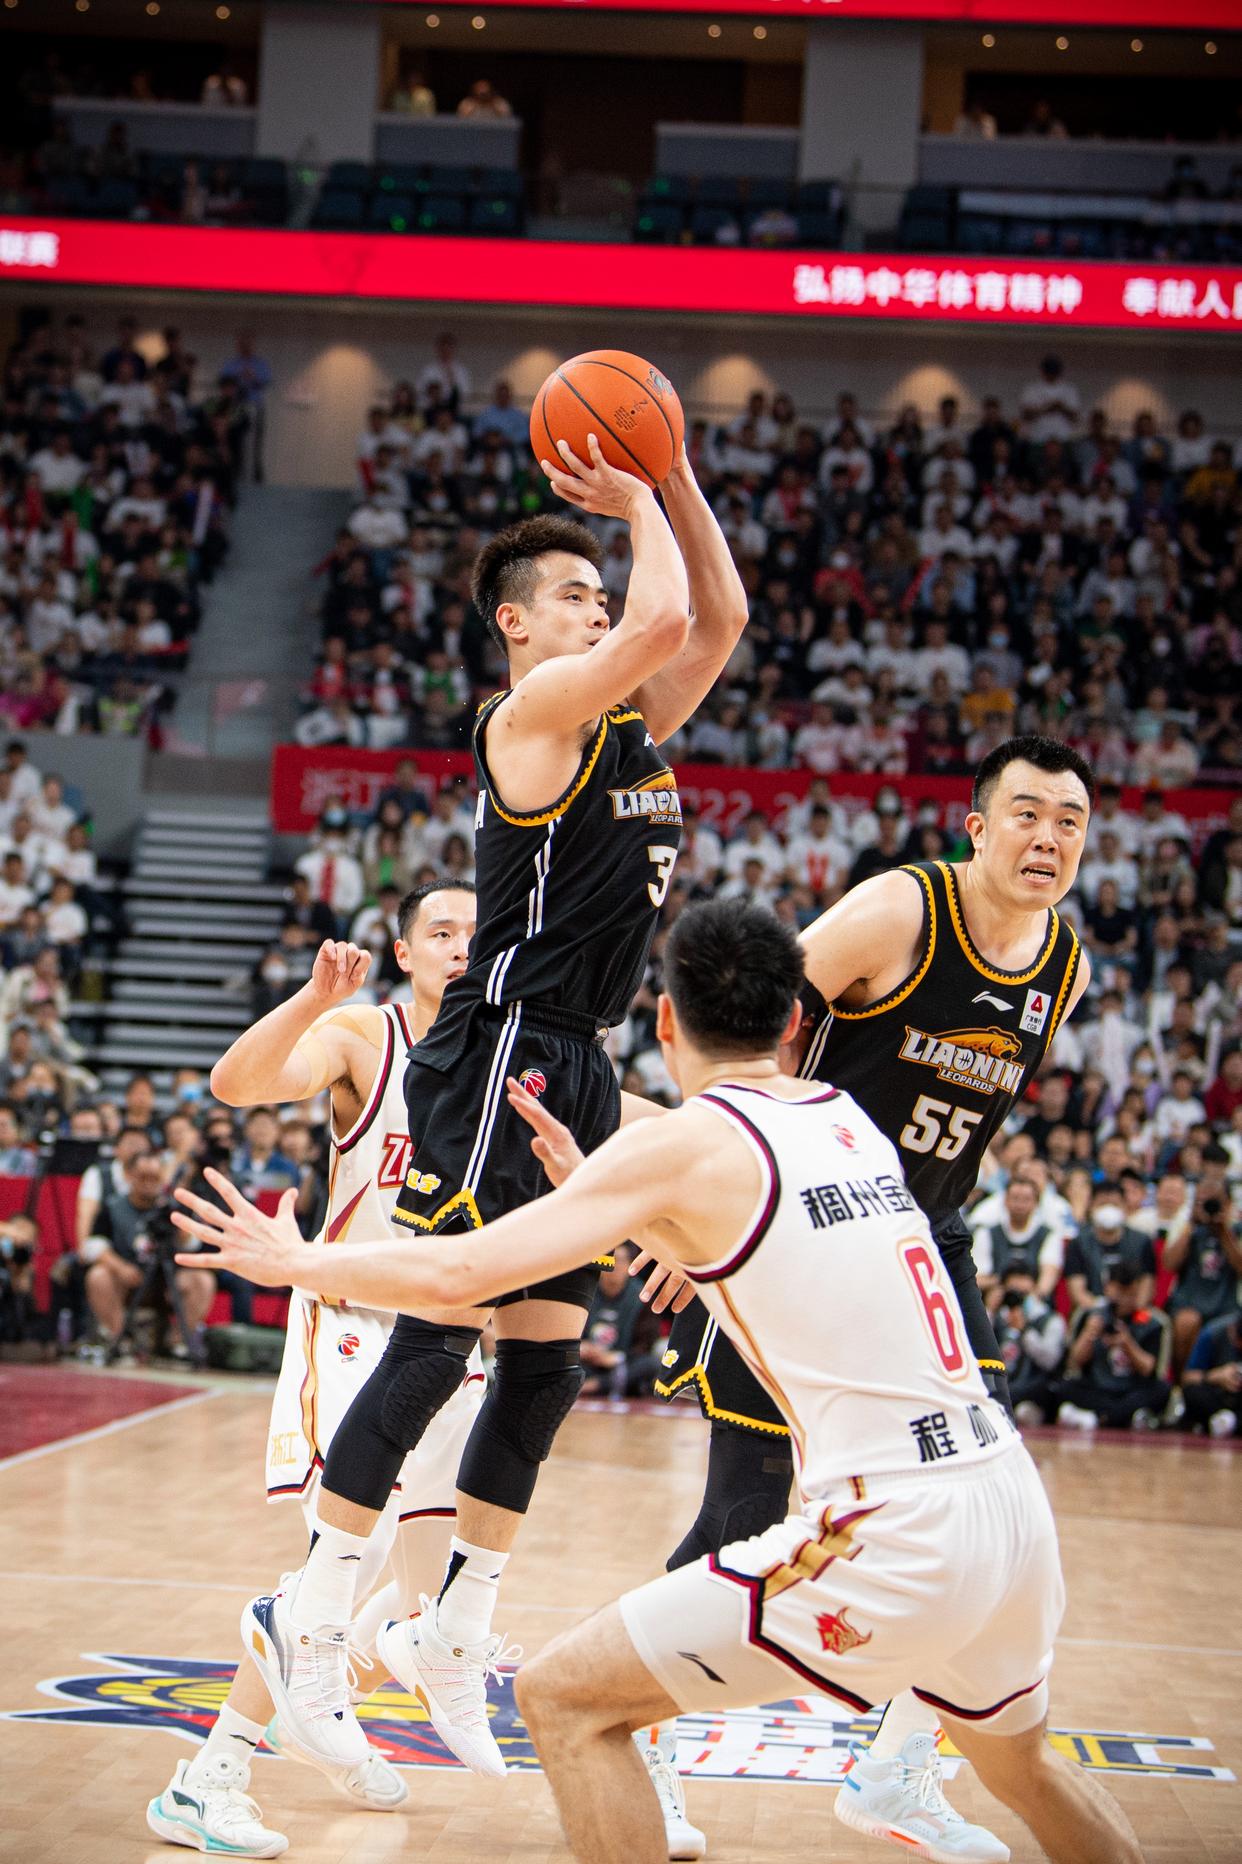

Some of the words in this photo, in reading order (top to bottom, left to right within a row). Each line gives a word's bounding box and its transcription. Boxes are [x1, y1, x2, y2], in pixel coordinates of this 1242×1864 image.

[794, 264, 1083, 314] 弘扬中华体育精神
[648, 845, 678, 908] 3
[940, 1068, 996, 1094] LEOPARDS
[900, 1094, 984, 1161] 55
[902, 1243, 965, 1377] 6
